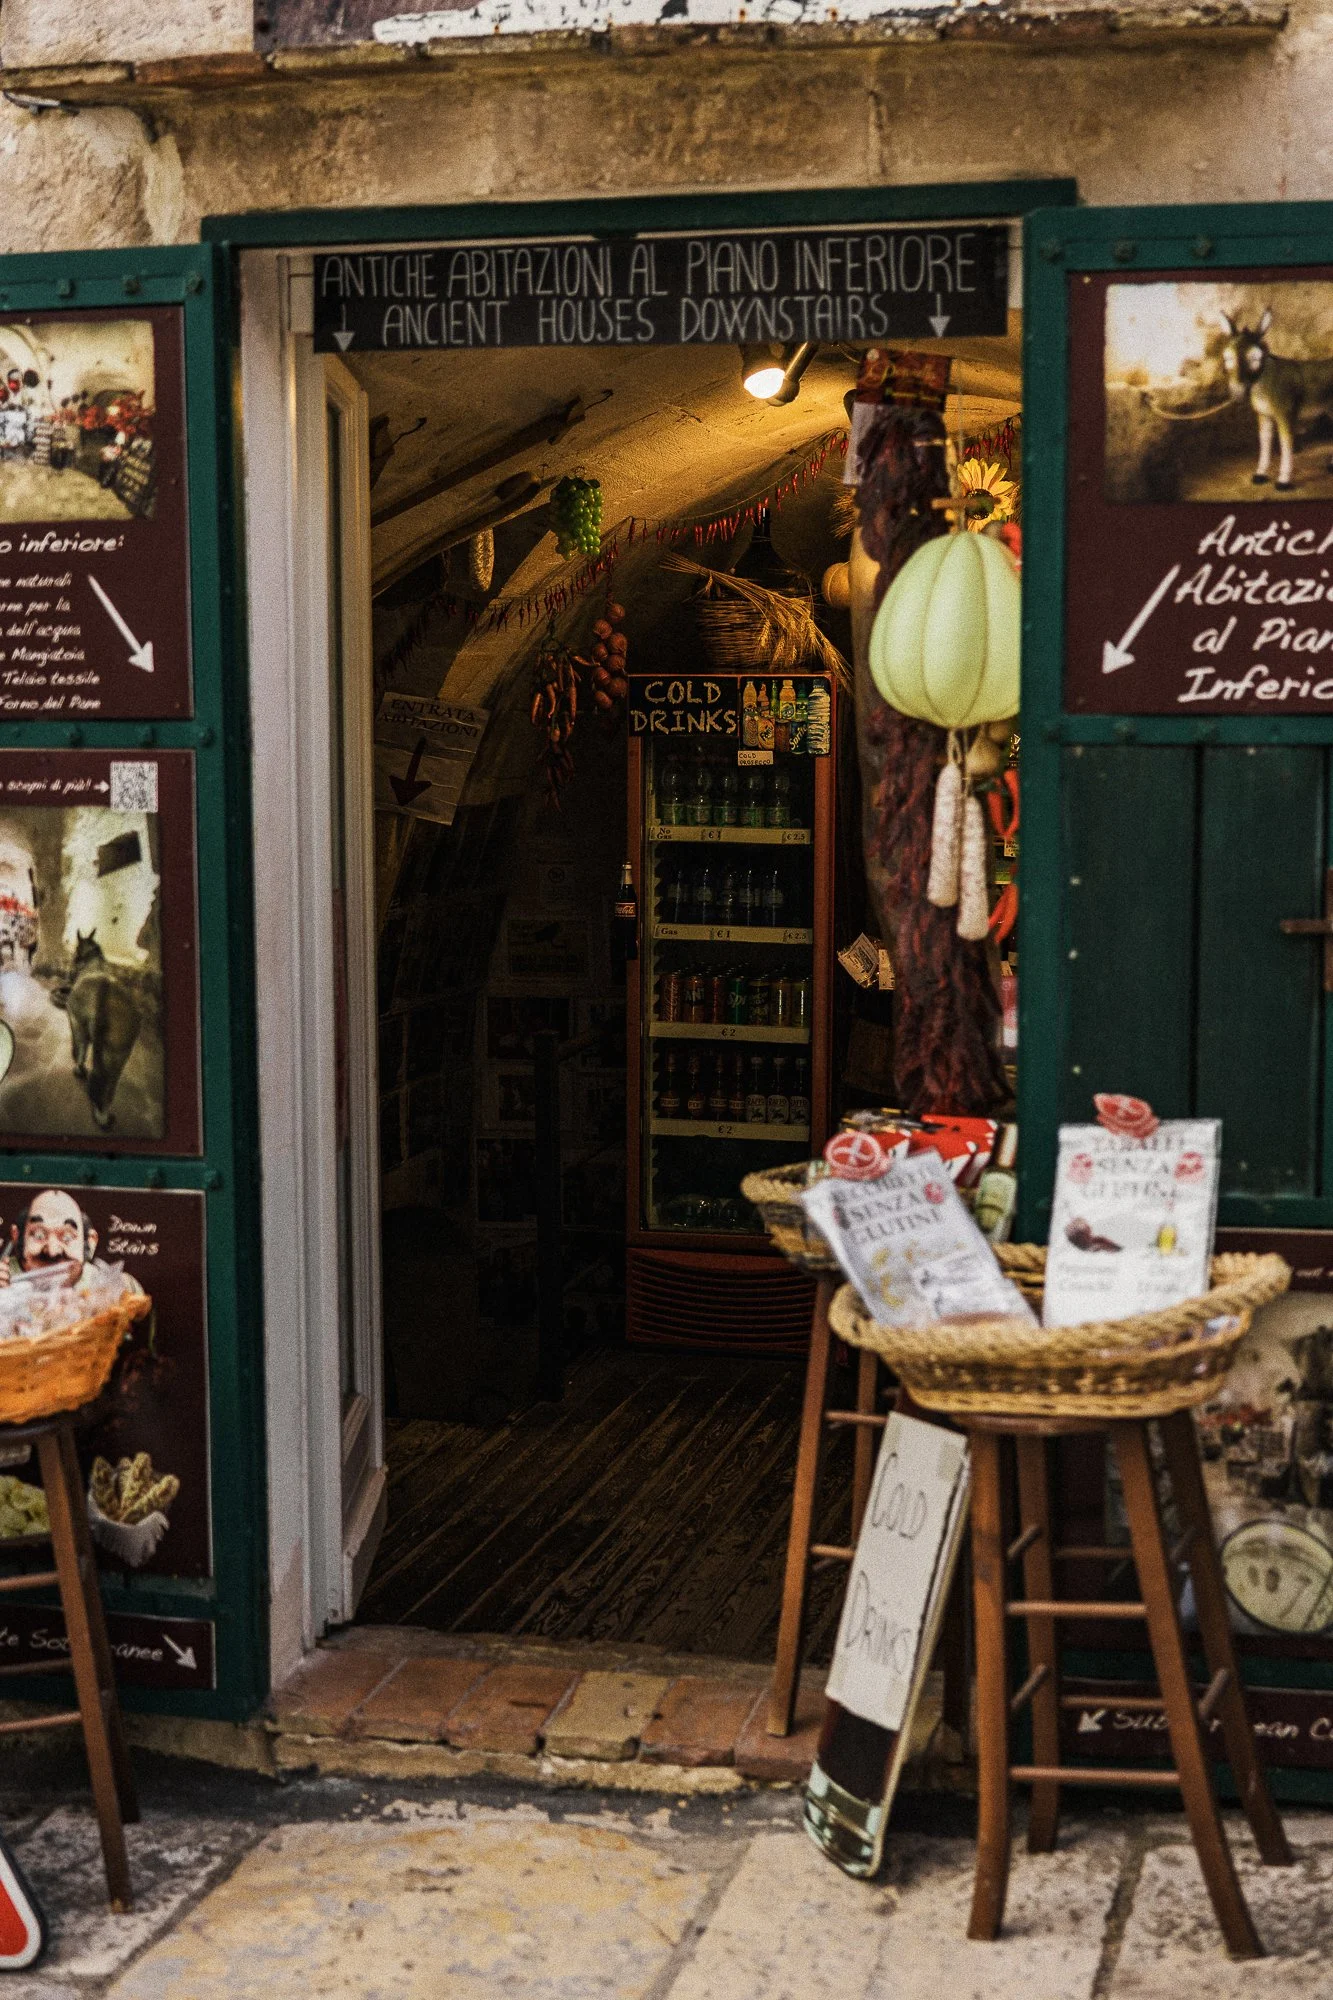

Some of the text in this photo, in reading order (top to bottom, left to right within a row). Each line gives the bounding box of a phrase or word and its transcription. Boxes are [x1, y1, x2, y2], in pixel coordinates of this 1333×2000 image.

[322, 233, 976, 297] ANTICHE ABITAZIONI AL PIANO INFERIORE
[382, 294, 888, 347] ANCIENT HOUSES DOWNSTAIRS
[19, 530, 124, 553] inferiore:
[1192, 616, 1238, 654] al
[644, 679, 722, 704] COLD
[391, 700, 475, 722] ENTRATA
[629, 708, 736, 734] DRINKS
[661, 928, 678, 936] Gas
